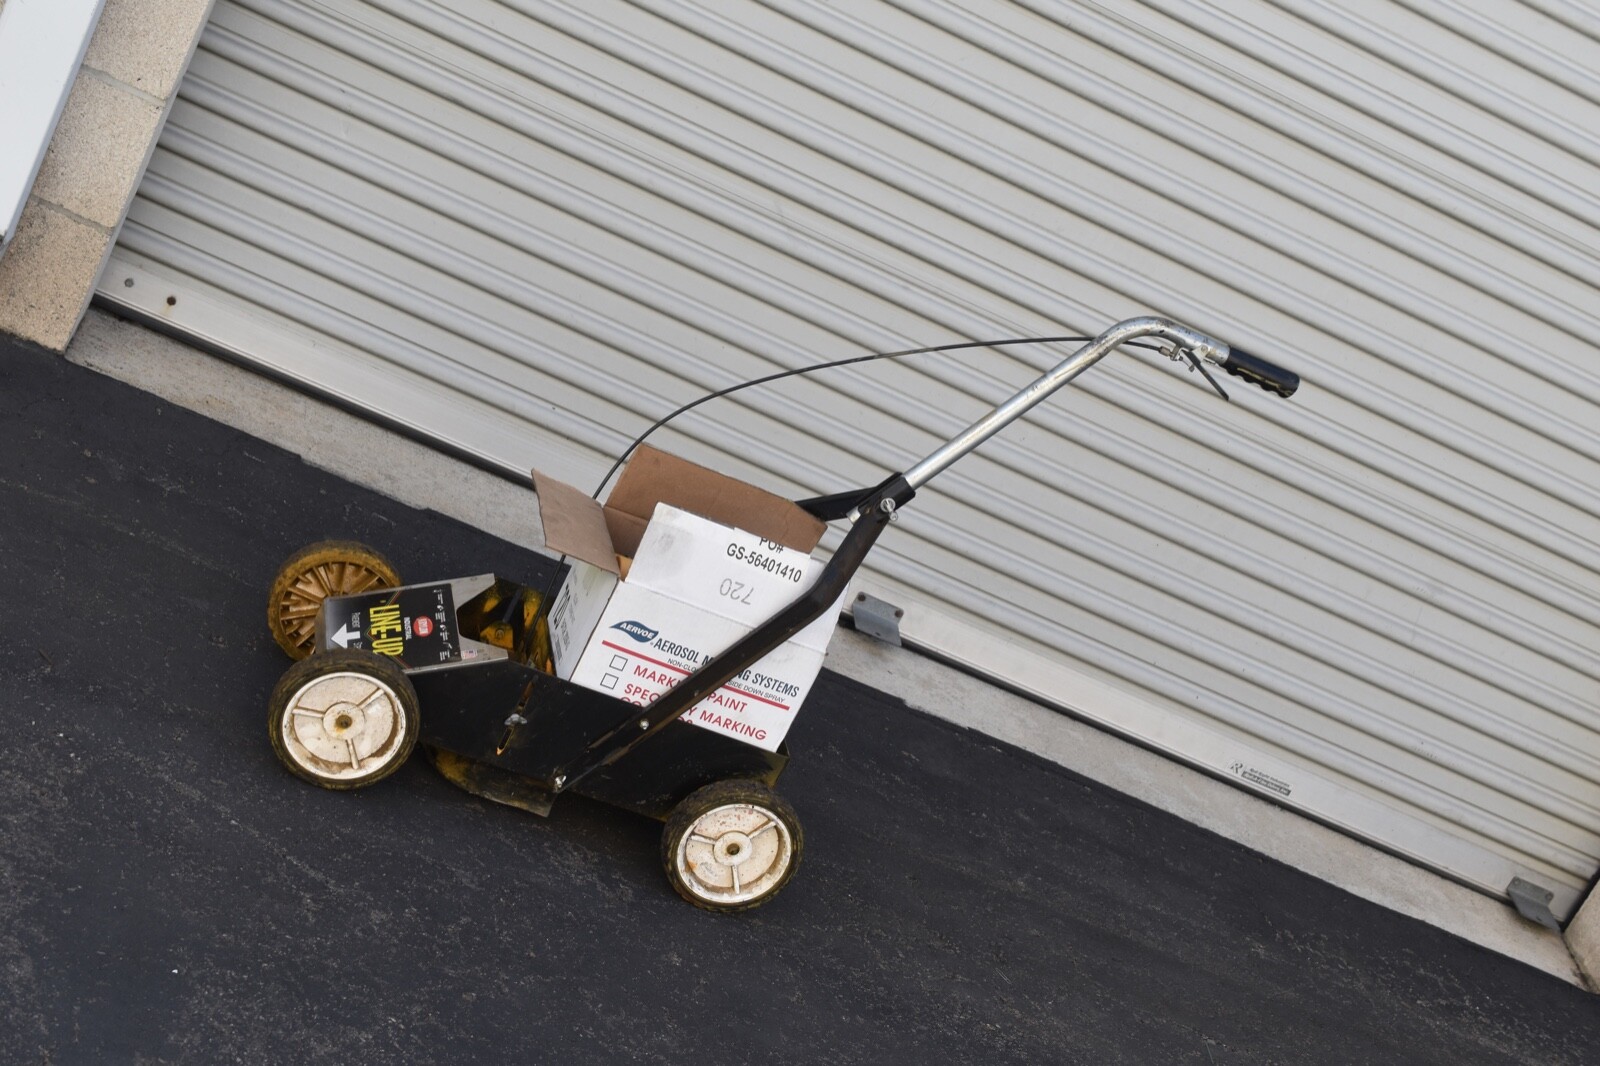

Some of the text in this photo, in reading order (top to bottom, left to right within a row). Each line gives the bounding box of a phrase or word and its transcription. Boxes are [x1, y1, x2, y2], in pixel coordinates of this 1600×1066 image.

[726, 543, 802, 583] GS-56401410
[719, 578, 755, 605] 720
[369, 604, 404, 656] LINE-UP
[619, 622, 655, 640] AERVOE
[653, 638, 800, 698] AEROSOL SYSTEMS
[706, 692, 748, 713] PAINT
[743, 685, 764, 697] DOWN
[763, 692, 786, 704] SPRAY
[700, 710, 767, 741] MARKING
